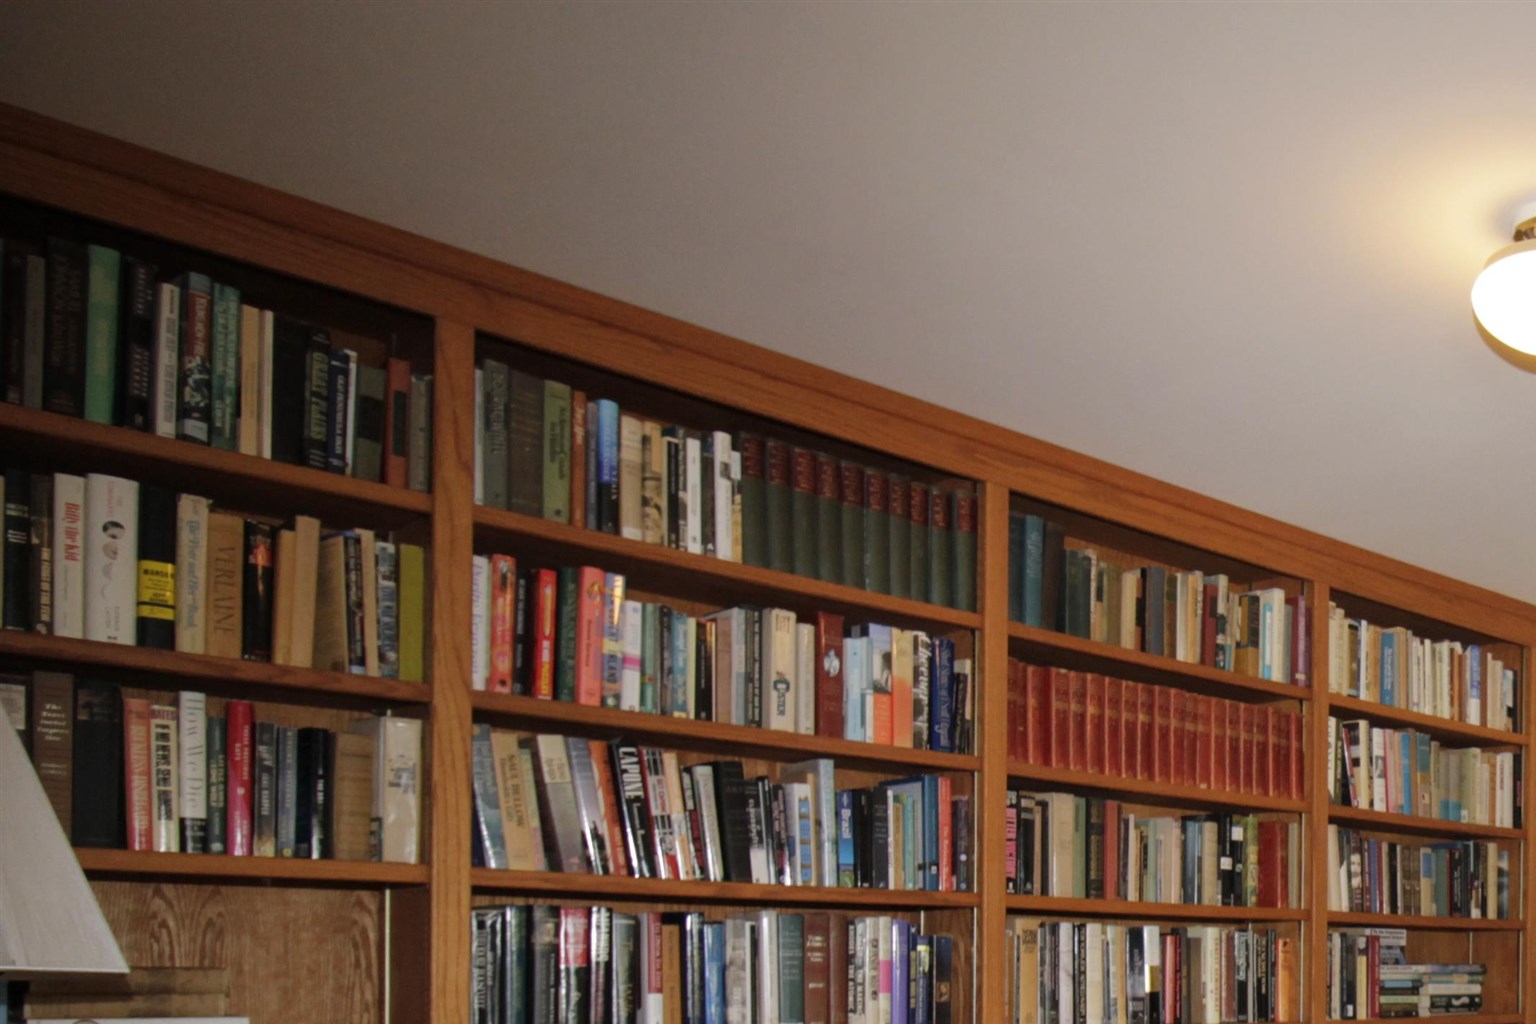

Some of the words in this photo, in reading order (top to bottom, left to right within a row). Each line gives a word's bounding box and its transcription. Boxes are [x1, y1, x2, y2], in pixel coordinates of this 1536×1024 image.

[311, 352, 328, 396] GREAT
[310, 397, 327, 441] PLAINS
[62, 502, 81, 524] Billy
[64, 526, 81, 540] the
[64, 544, 81, 562] Kid
[213, 546, 237, 633] VERLAINE
[773, 679, 790, 716] CUSTER
[186, 699, 204, 736] How
[155, 732, 171, 742] NO
[186, 745, 204, 773] We
[507, 754, 519, 778] SAUL
[618, 747, 645, 798] CAPONE
[185, 778, 204, 809] Die
[510, 784, 525, 828] BELLOW
[840, 808, 853, 839] Brazil
